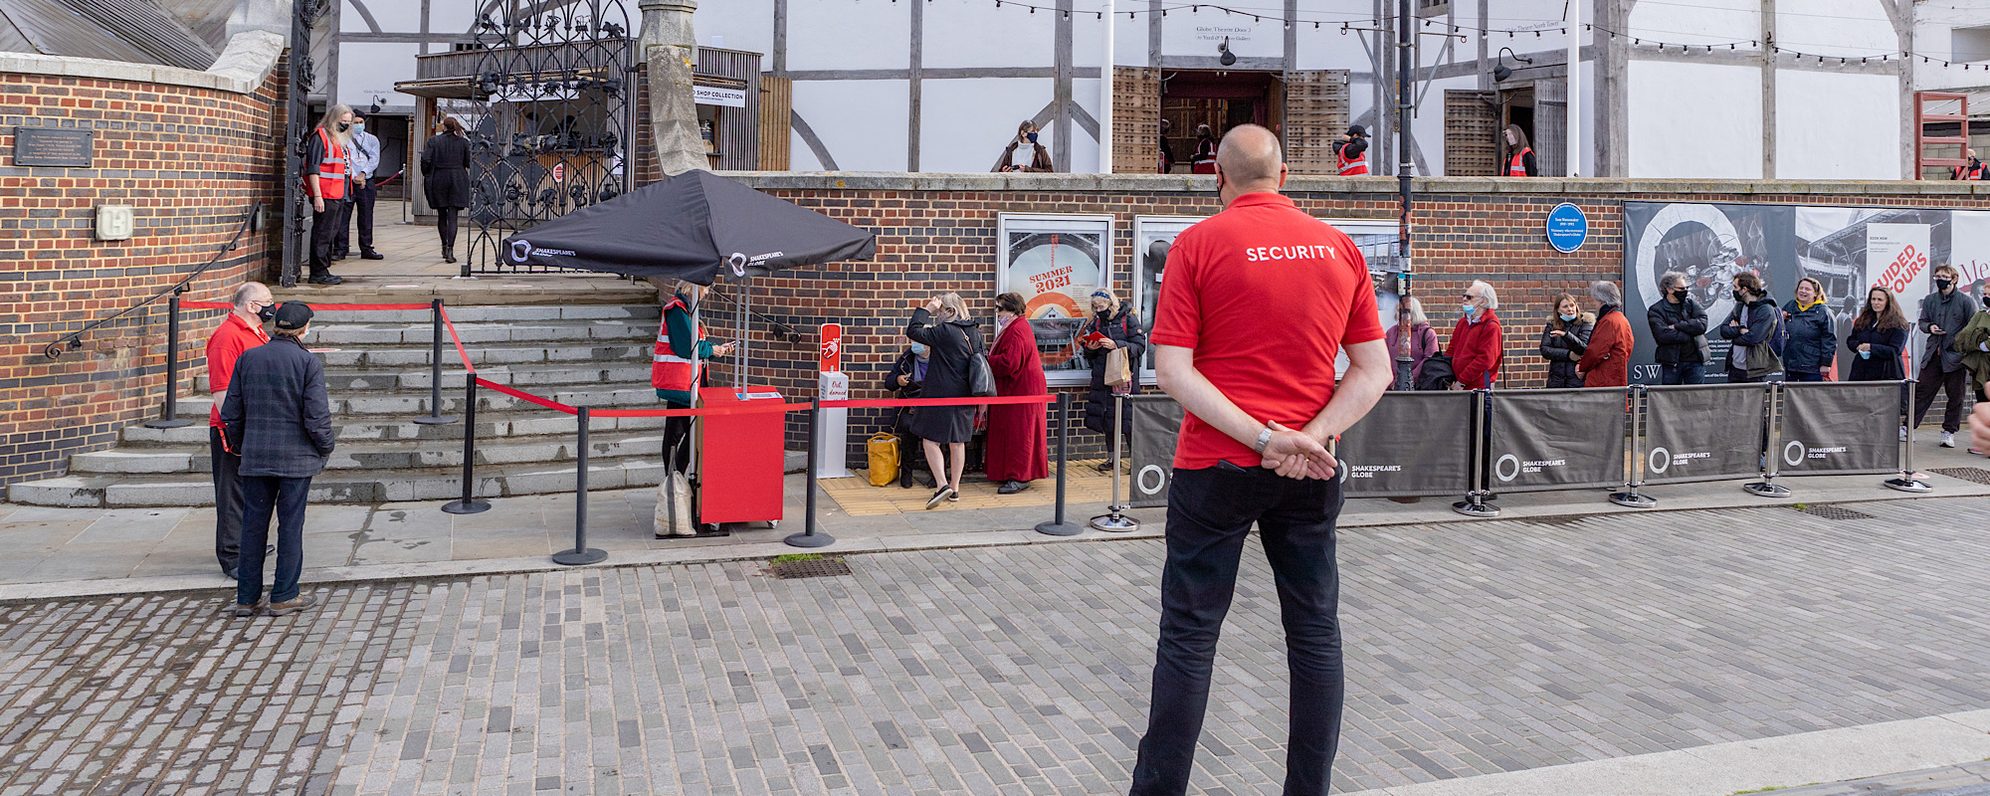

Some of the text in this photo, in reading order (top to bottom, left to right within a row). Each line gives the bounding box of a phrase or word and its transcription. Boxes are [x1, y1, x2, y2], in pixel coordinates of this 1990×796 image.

[711, 91, 743, 100] COLLECTION
[1246, 245, 1336, 262] SECURITY
[1029, 265, 1073, 283] SUMMER
[1890, 252, 1927, 293] OURS
[1959, 259, 1990, 286] Me
[1036, 275, 1071, 294] 2021
[1633, 364, 1661, 379] SW
[1522, 459, 1566, 467] SHAKESPEARE'S
[1673, 452, 1711, 460] SHAKESPEARE'S
